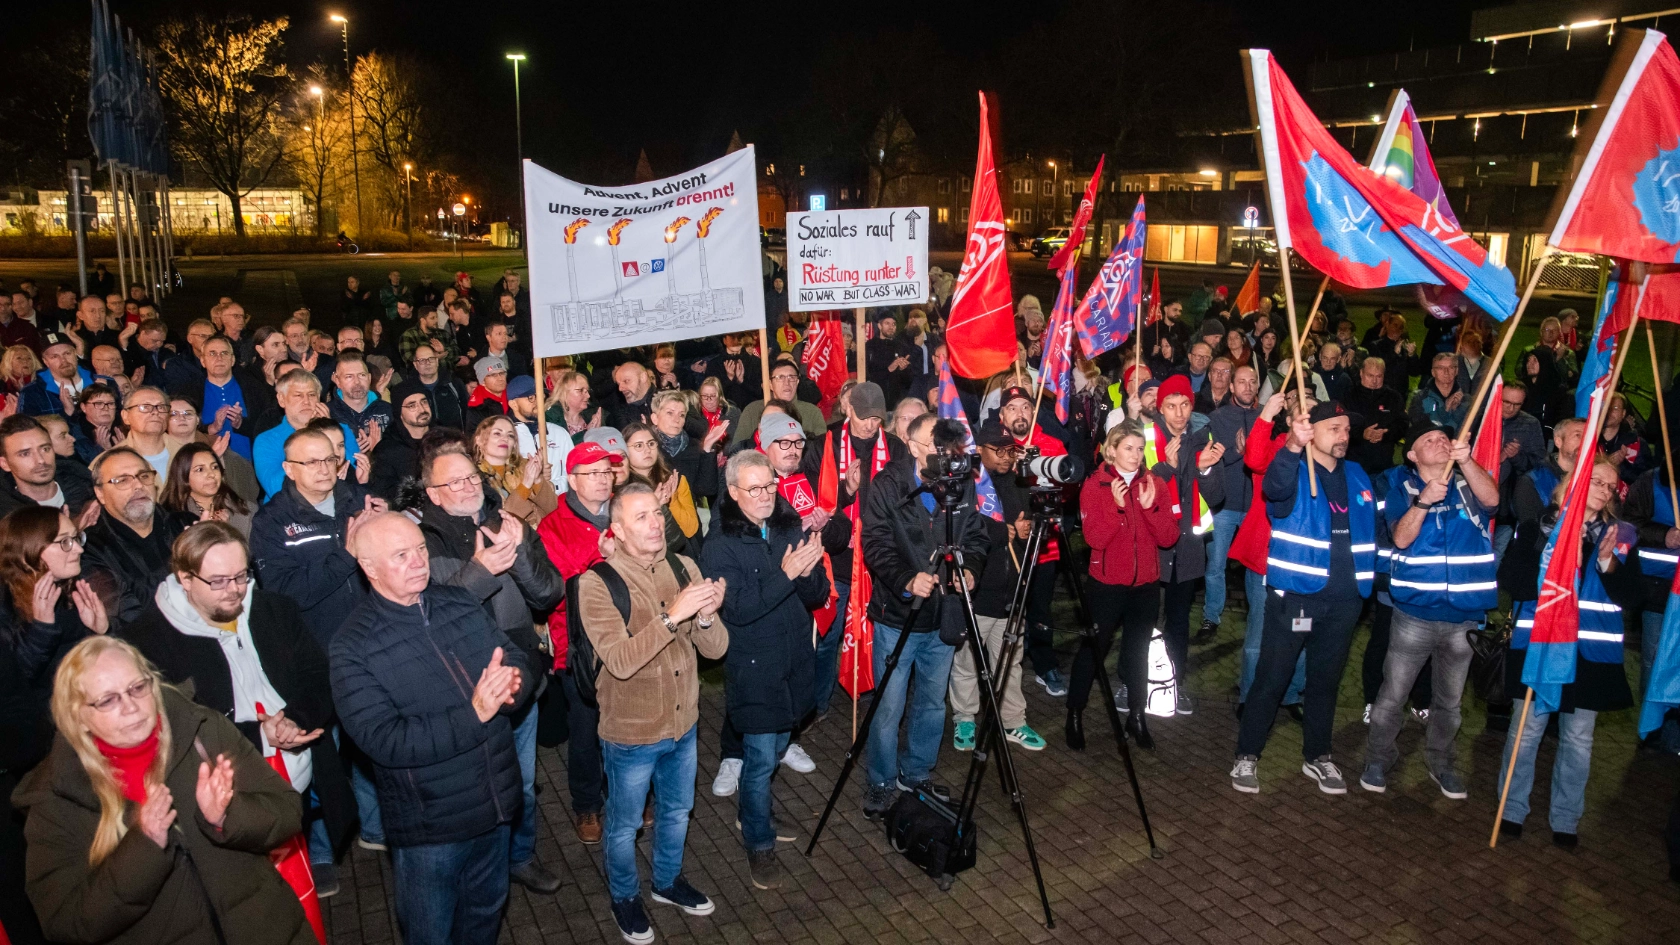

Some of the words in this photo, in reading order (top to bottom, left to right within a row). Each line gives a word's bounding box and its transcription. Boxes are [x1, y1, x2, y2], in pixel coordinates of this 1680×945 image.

[548, 202, 609, 217] unsere
[611, 200, 674, 217] Zukunft
[676, 182, 735, 206] brennt!
[583, 187, 649, 200] Advent,
[651, 172, 707, 198] Advent
[797, 213, 857, 240] Soziales
[866, 211, 896, 242] rauf
[799, 243, 832, 260] dafür:
[802, 262, 859, 286] Rüstung
[865, 260, 902, 282] runter
[800, 291, 814, 302] NO
[816, 290, 835, 302] WAR
[843, 288, 860, 300] BUT
[863, 283, 917, 299] CLASS-WAR
[1090, 300, 1114, 349] CARIAD
